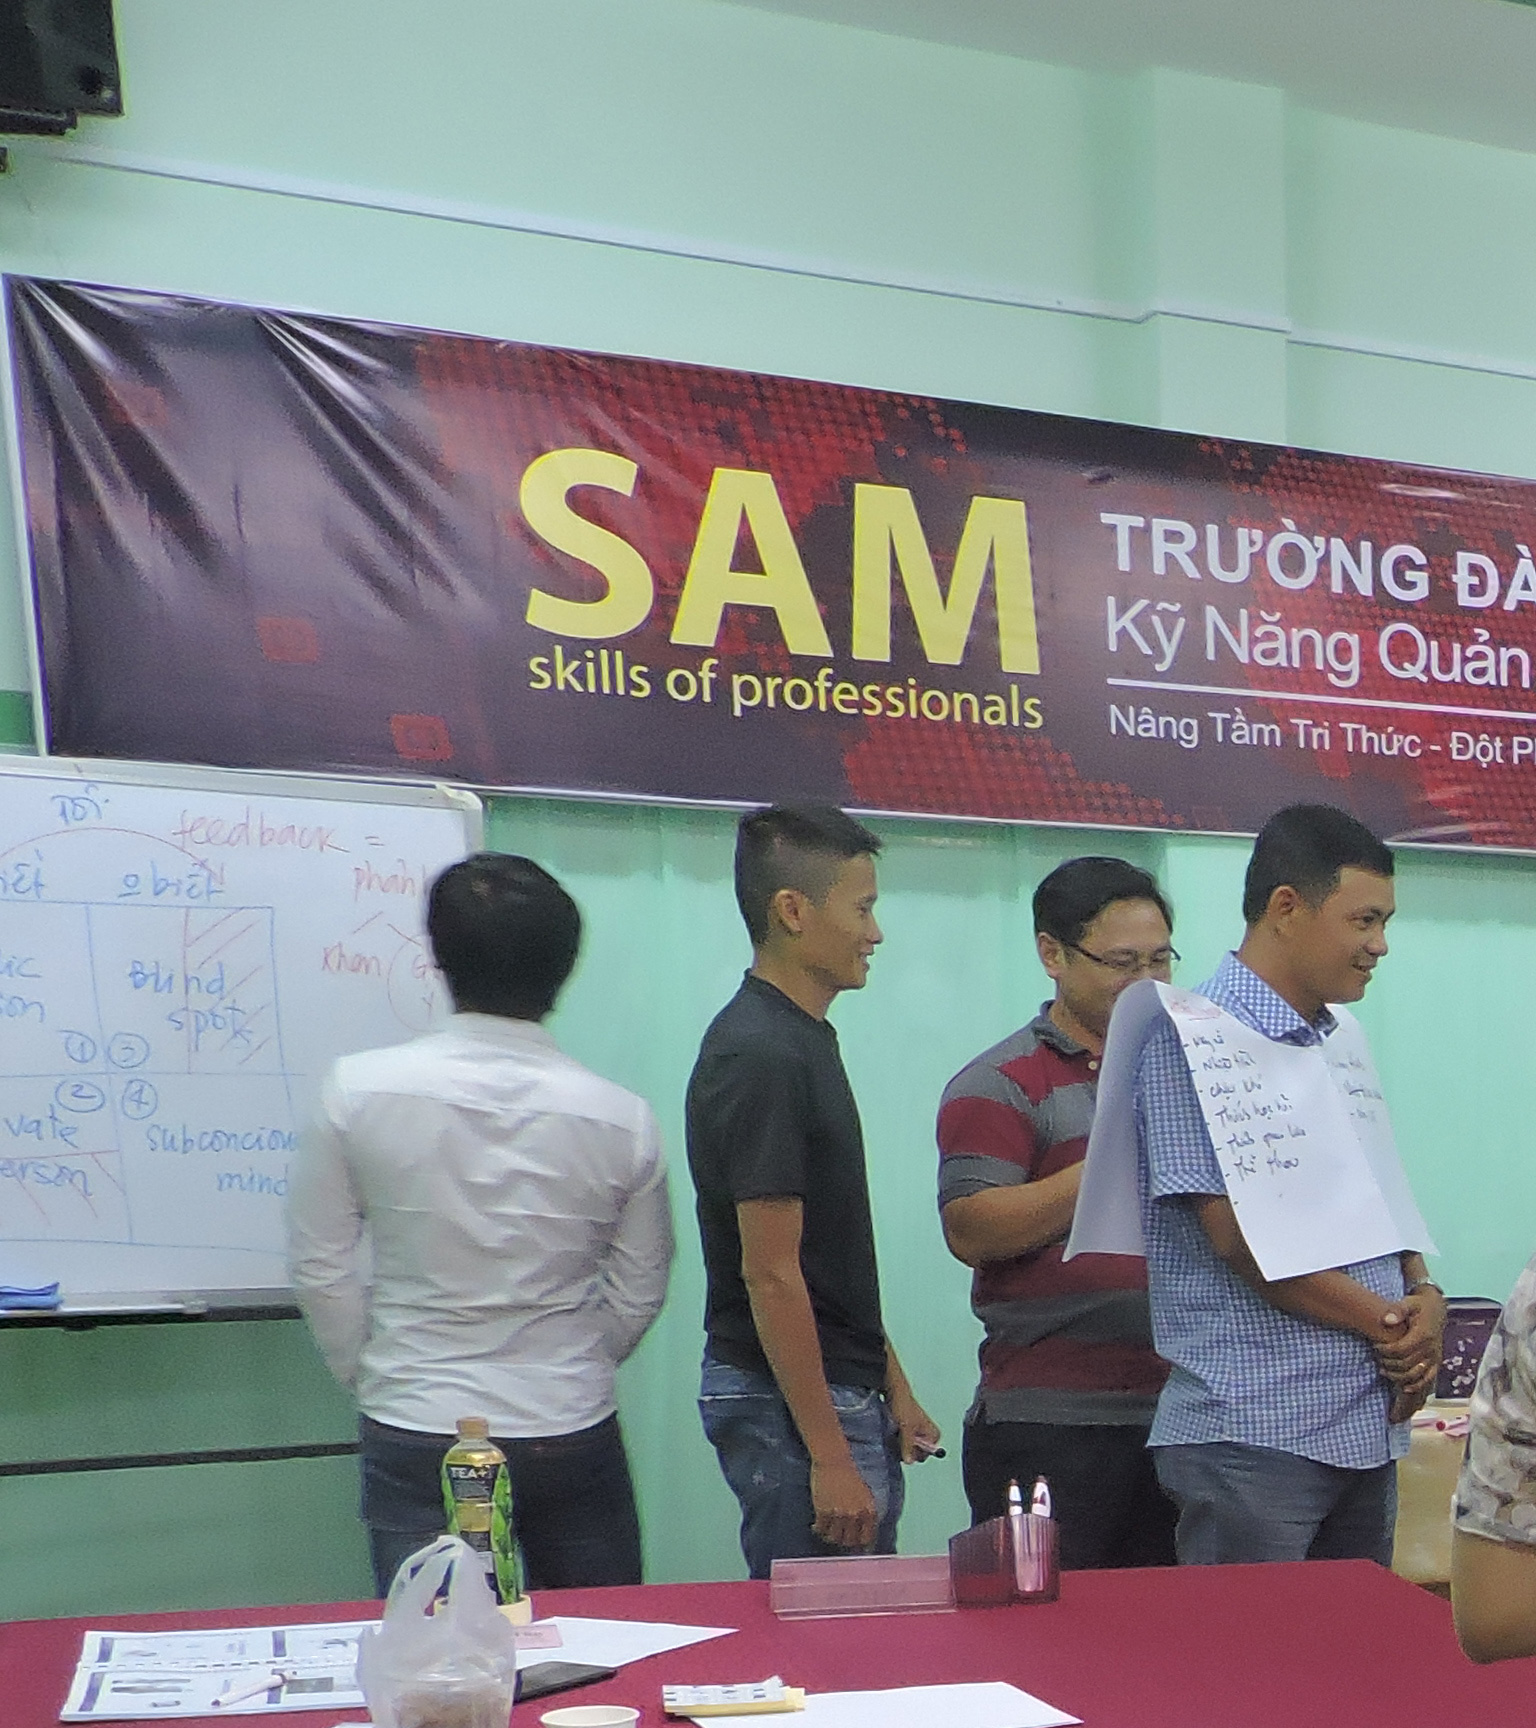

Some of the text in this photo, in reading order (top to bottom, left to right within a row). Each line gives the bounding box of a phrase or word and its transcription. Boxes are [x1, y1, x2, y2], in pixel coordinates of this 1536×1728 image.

[516, 447, 1041, 675] SAM
[1101, 512, 1430, 602] TRƯỜNG
[1107, 596, 1187, 673] Kỹ
[1204, 602, 1361, 688] Năng
[1378, 622, 1531, 692] Quản
[528, 645, 1044, 729] skills of professionals
[1109, 703, 1199, 749] Nâng
[1207, 706, 1282, 747] Tầm
[1339, 722, 1422, 758] Thức
[1449, 730, 1505, 766] Đột
[172, 806, 350, 854] feedback
[4, 1103, 79, 1148] vate
